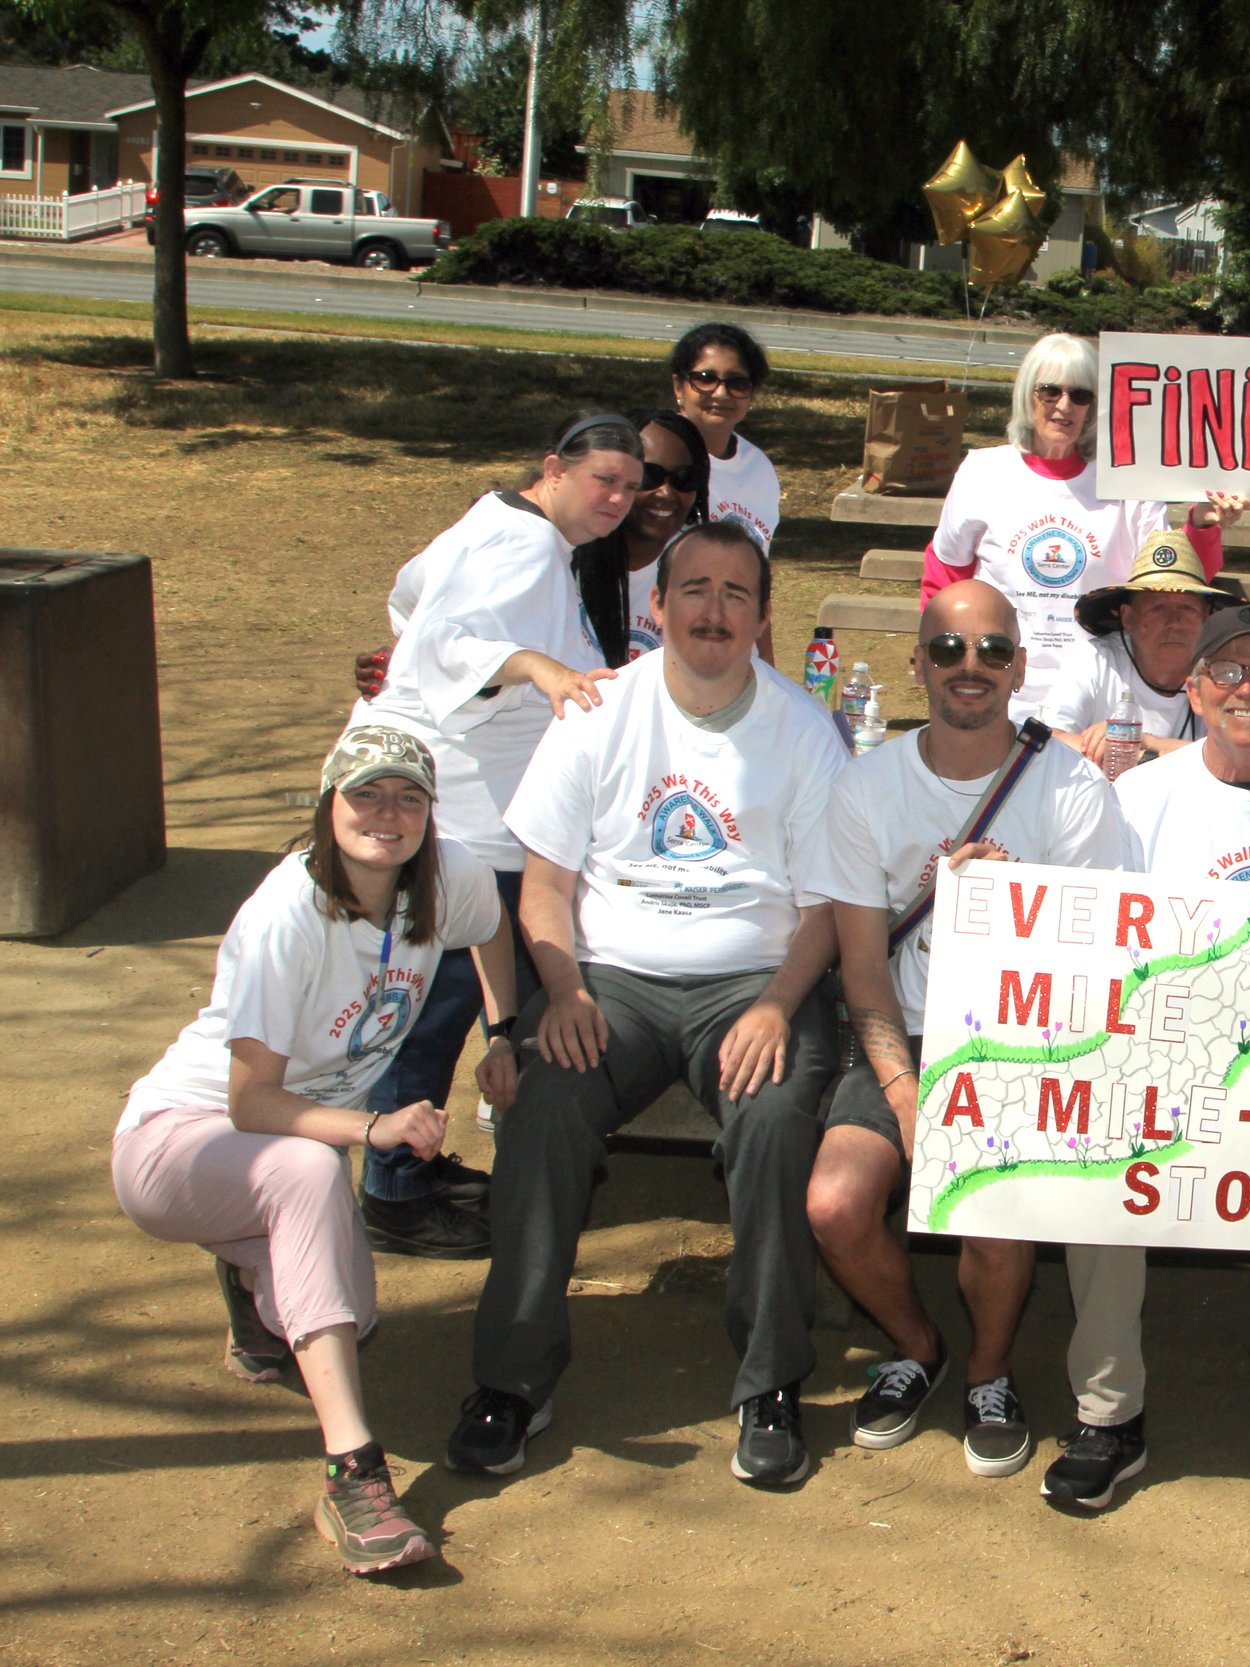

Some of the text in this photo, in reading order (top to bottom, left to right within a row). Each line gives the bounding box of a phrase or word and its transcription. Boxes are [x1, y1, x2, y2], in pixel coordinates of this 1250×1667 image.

[1007, 514, 1101, 558] 2025 Walk This Way
[636, 615, 663, 636] This
[379, 732, 406, 757] B
[637, 773, 741, 842] 2025 Wa This Way
[667, 836, 684, 845] Serra
[954, 876, 1214, 956] EVERY
[329, 1000, 362, 1039] 2025
[997, 970, 1191, 1043] MILE
[941, 1071, 985, 1128] A
